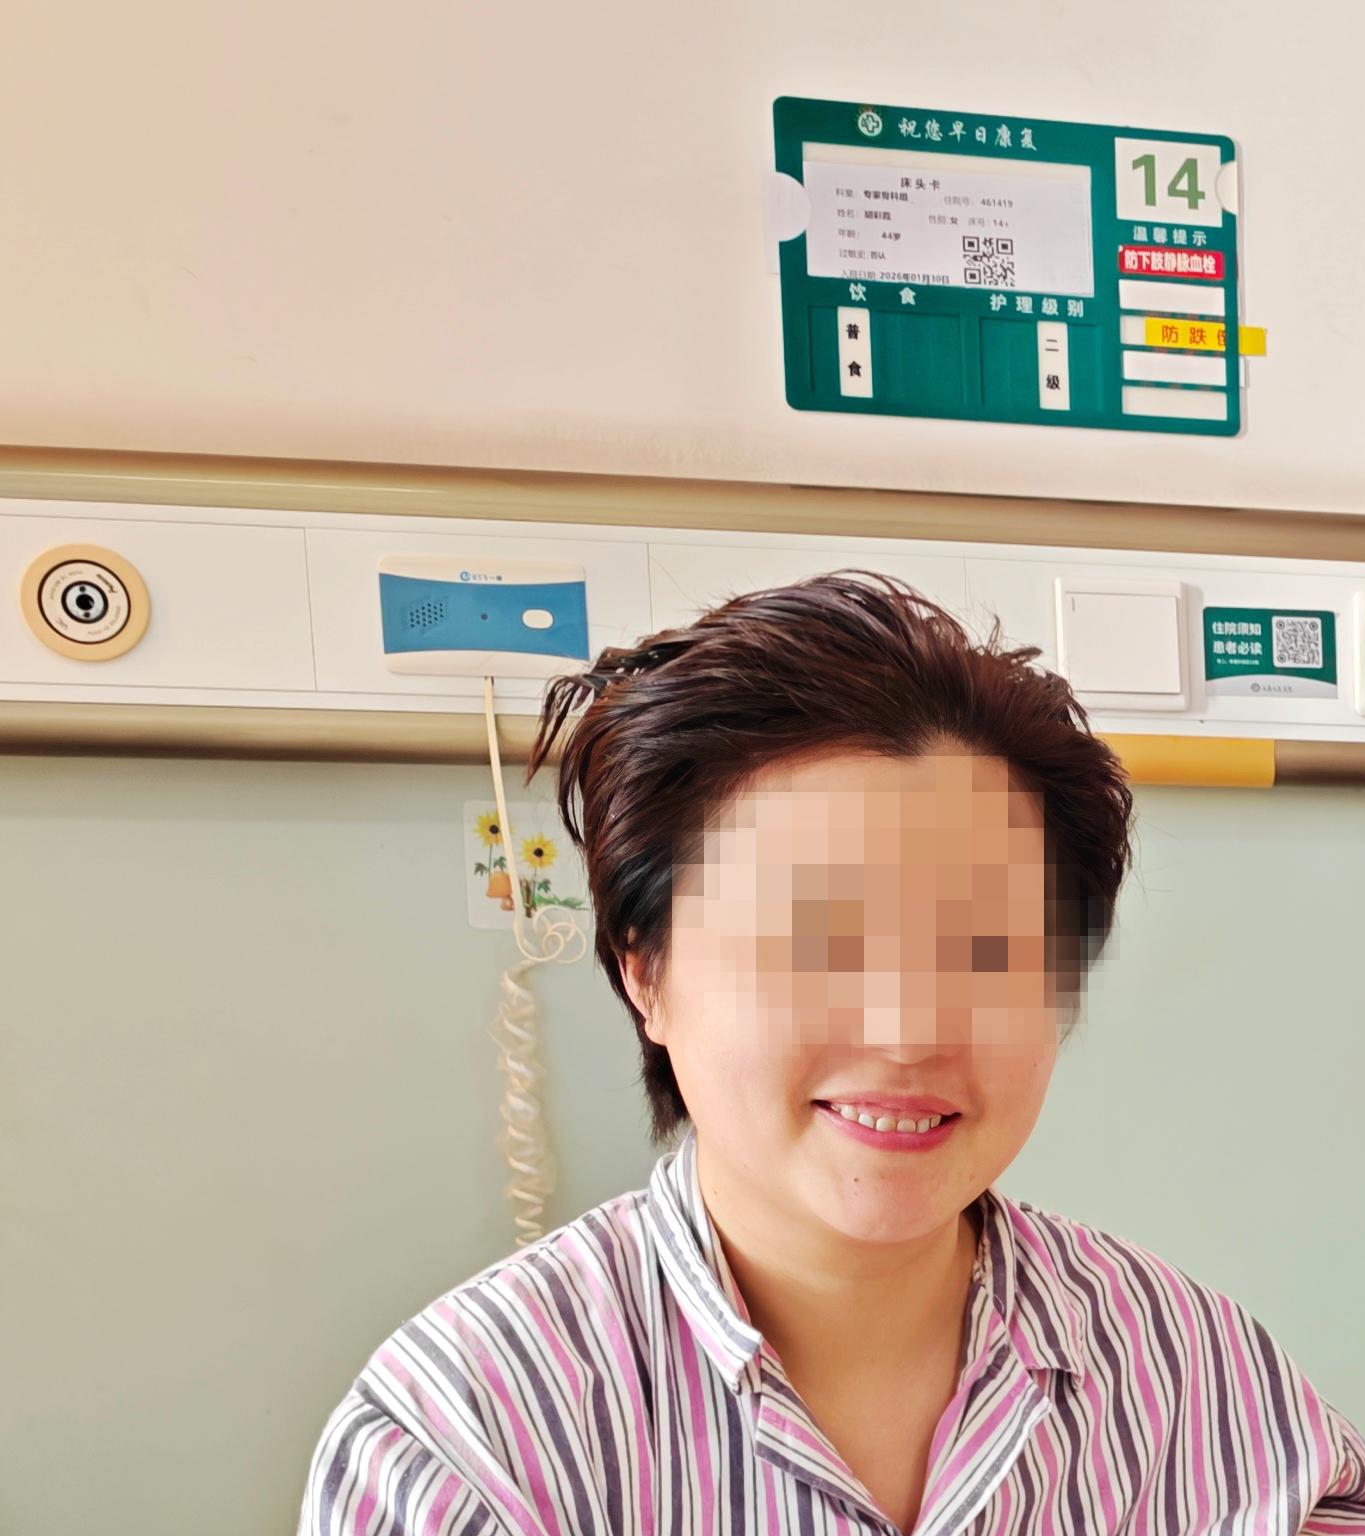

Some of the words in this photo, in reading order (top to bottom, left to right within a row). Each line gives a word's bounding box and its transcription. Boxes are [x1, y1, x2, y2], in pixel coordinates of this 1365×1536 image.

[898, 117, 1038, 151] 祝您早日康复
[900, 177, 940, 191] 床头卡
[1131, 154, 1206, 209] 14
[1133, 225, 1207, 246] 温馨提示
[1124, 249, 1217, 275] 防下肢静脉血栓
[990, 293, 1084, 318] 护理级别
[846, 323, 862, 378] 普食
[1045, 338, 1060, 391] 二级
